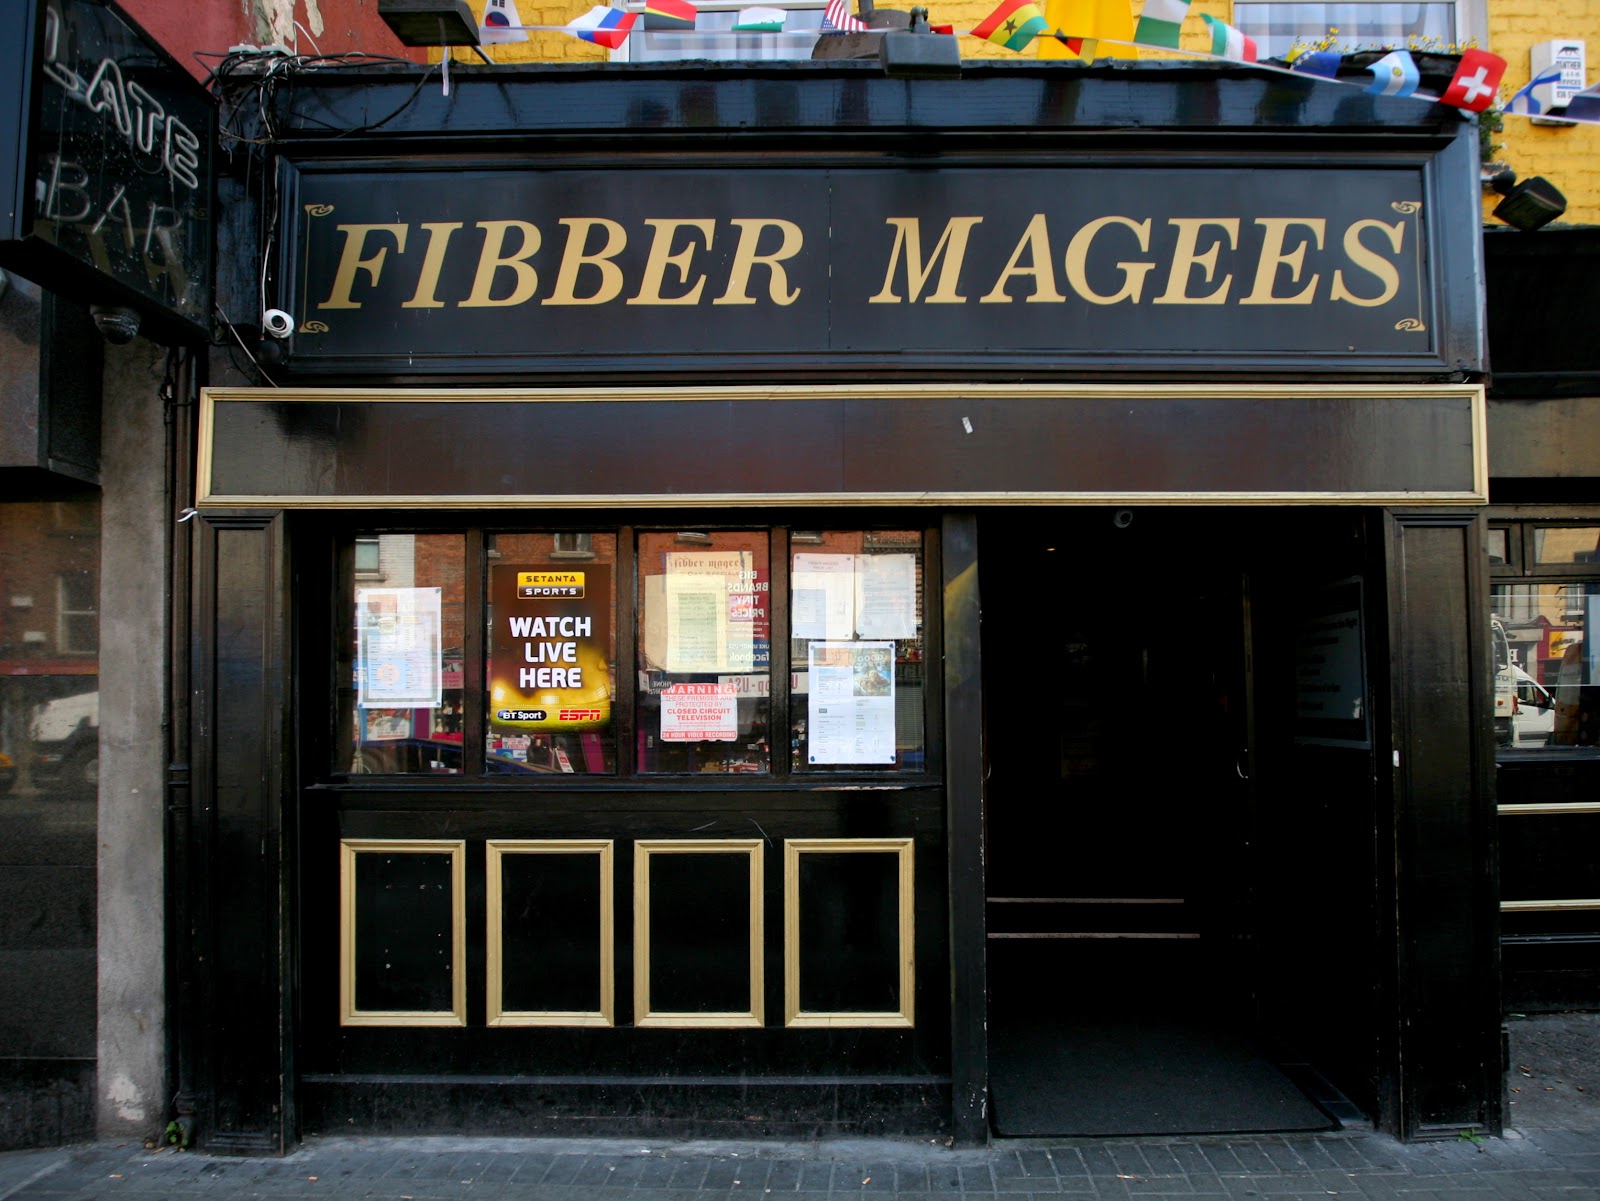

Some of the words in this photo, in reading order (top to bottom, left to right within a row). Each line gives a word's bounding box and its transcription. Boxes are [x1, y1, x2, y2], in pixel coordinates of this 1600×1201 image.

[43, 6, 200, 190] LATE
[46, 154, 183, 264] BAR
[317, 217, 806, 310] FIBBER
[868, 213, 1407, 307] MAGEES
[708, 559, 744, 569] magee
[525, 575, 577, 583] SETANTA
[525, 587, 577, 596] SPORTS
[509, 616, 592, 638] WATCH
[524, 642, 577, 663] LIVE
[519, 667, 582, 689] HERE
[665, 685, 734, 694] WARNING
[503, 711, 516, 720] BT
[517, 711, 542, 722] Sport
[559, 710, 601, 721] ESPN
